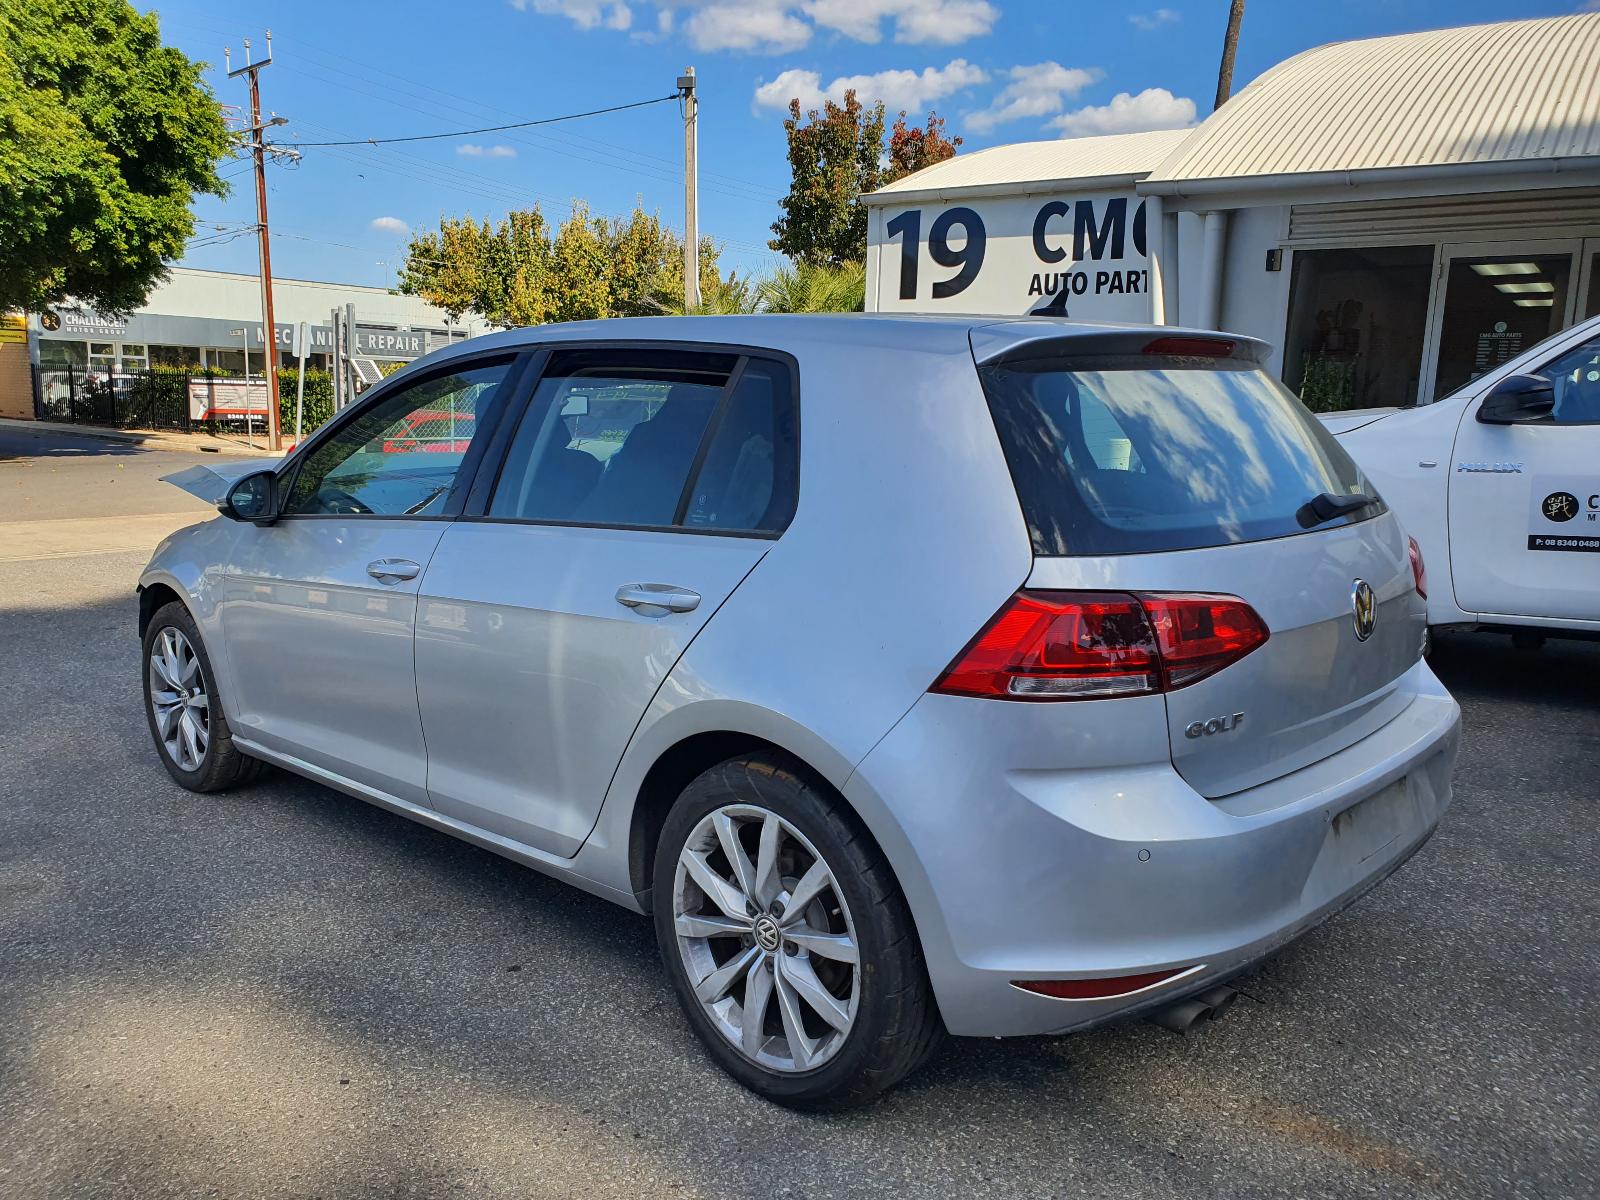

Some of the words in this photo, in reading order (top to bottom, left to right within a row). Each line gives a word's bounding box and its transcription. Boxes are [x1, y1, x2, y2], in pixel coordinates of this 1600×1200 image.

[886, 206, 987, 300] 19
[1028, 271, 1088, 296] AUTO
[256, 327, 362, 348] MECANIL
[368, 334, 419, 350] REPAIR
[1557, 539, 1577, 547] 8340
[1579, 540, 1600, 548] 0488
[1184, 711, 1245, 740] GOLF
